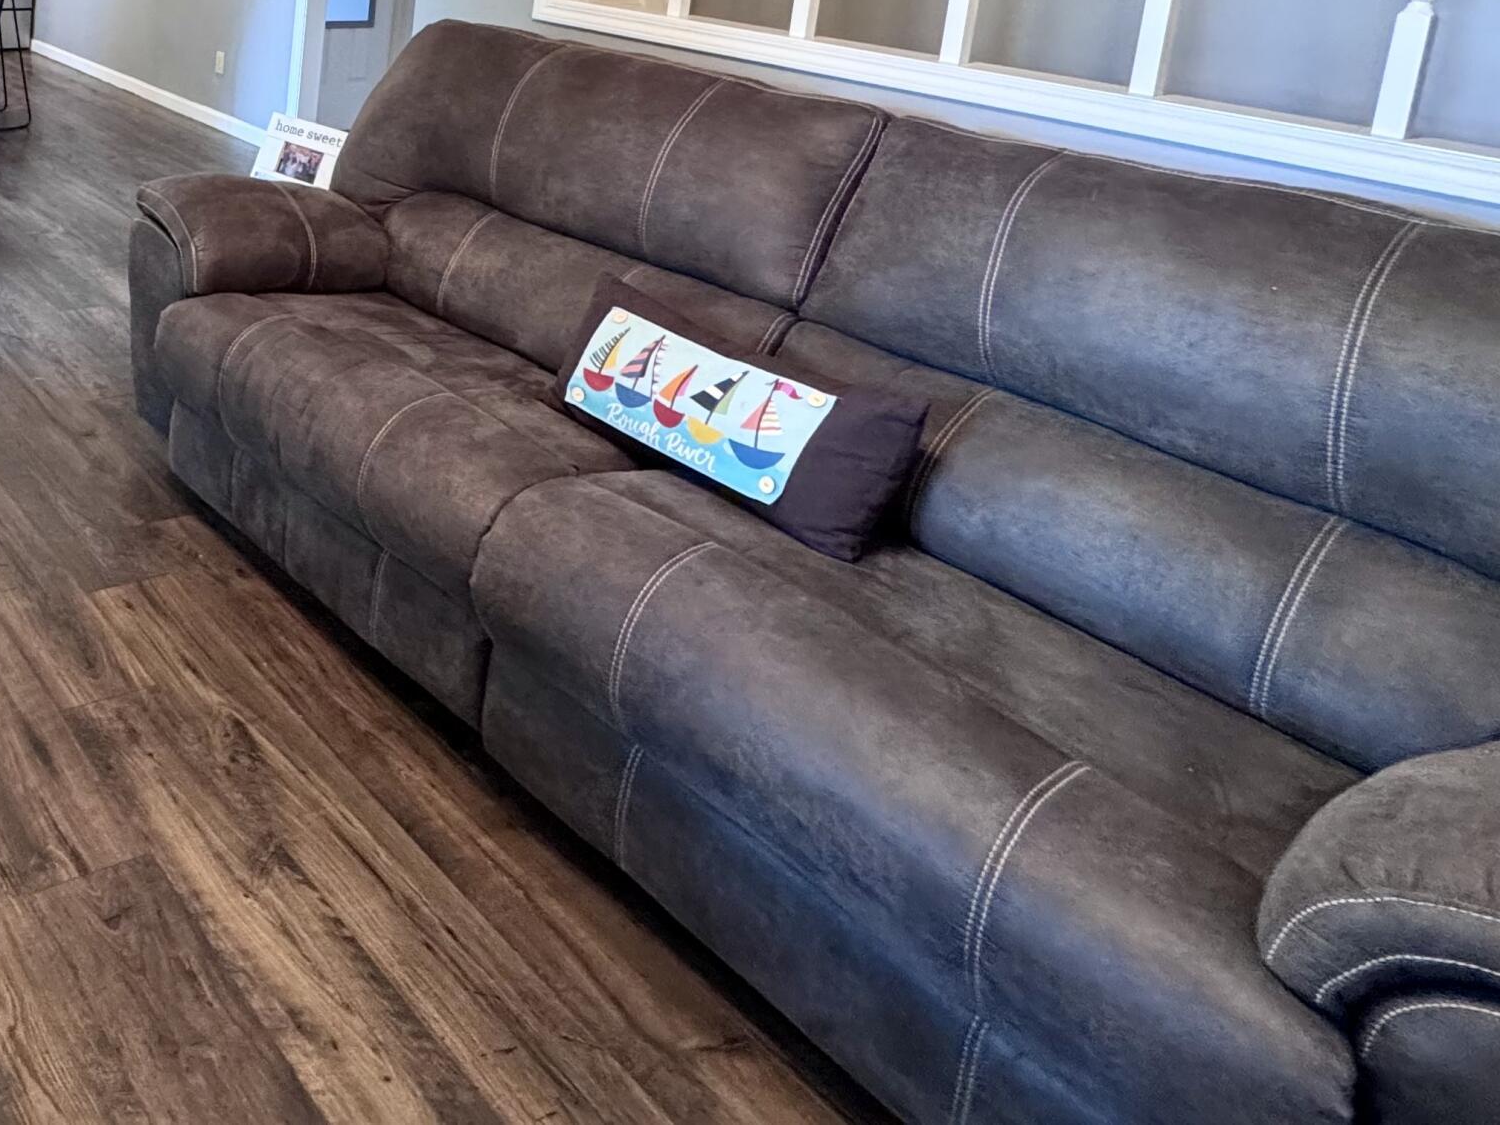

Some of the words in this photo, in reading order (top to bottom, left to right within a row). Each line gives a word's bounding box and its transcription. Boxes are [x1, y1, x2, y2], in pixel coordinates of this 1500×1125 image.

[275, 118, 305, 137] home
[306, 129, 344, 148] sweet
[606, 402, 661, 448] Rough
[664, 431, 716, 474] River
